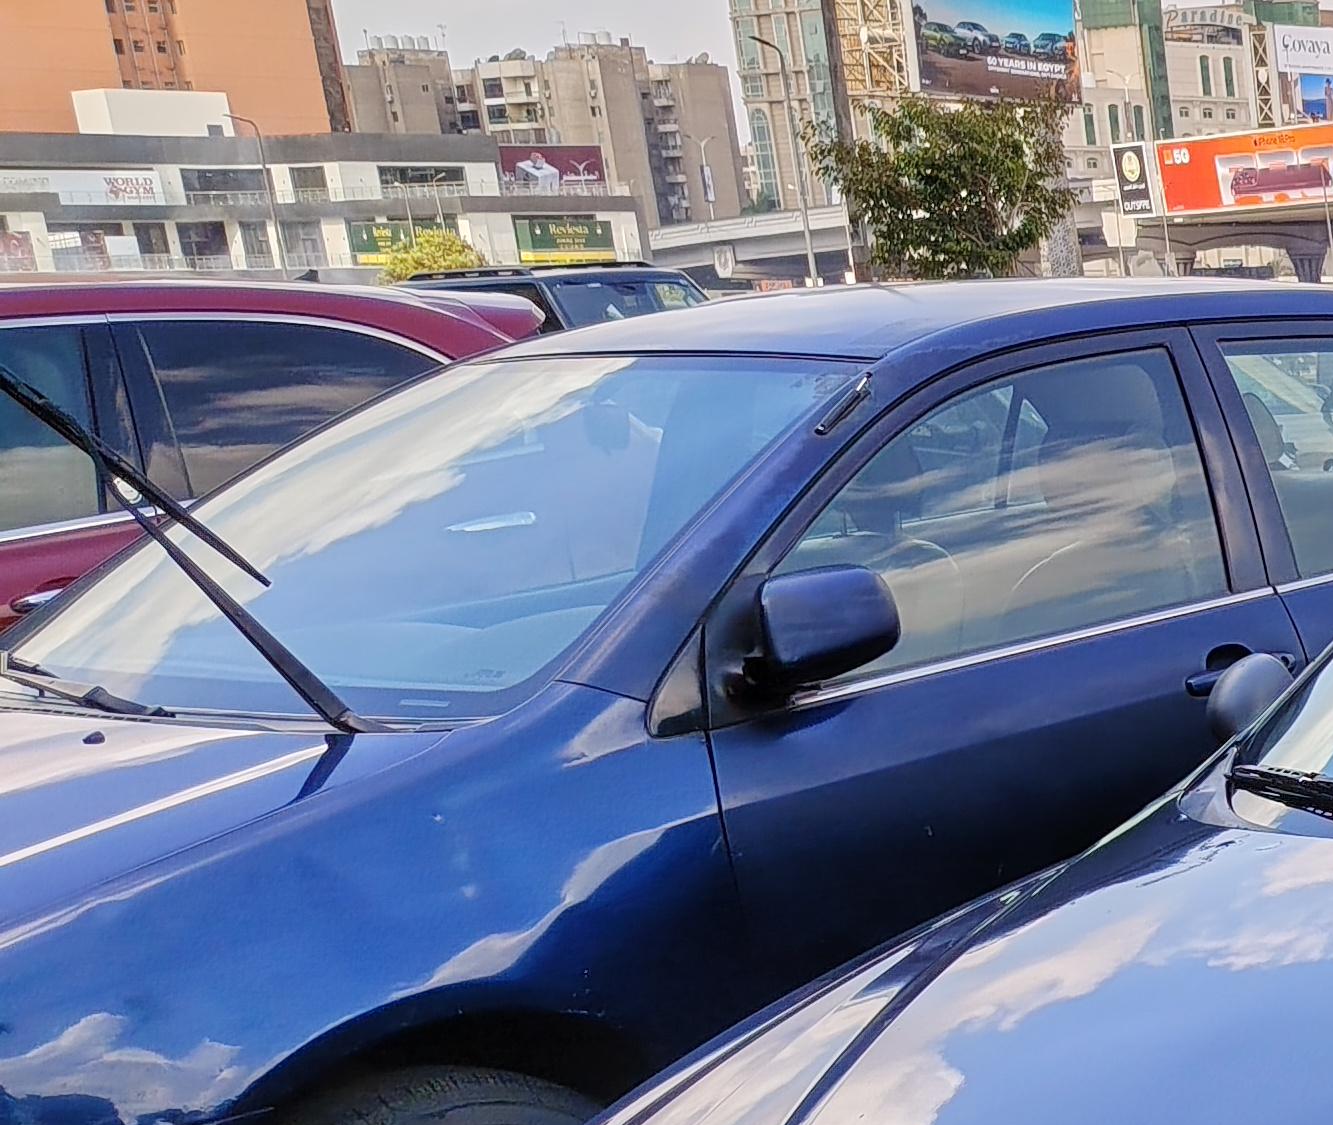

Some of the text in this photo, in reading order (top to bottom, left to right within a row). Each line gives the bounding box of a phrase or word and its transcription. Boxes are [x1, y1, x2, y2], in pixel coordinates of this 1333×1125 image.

[998, 57, 1026, 69] YEARS
[1027, 60, 1036, 70] IN
[1037, 62, 1066, 73] EGYPT
[103, 177, 153, 186] WORLD
